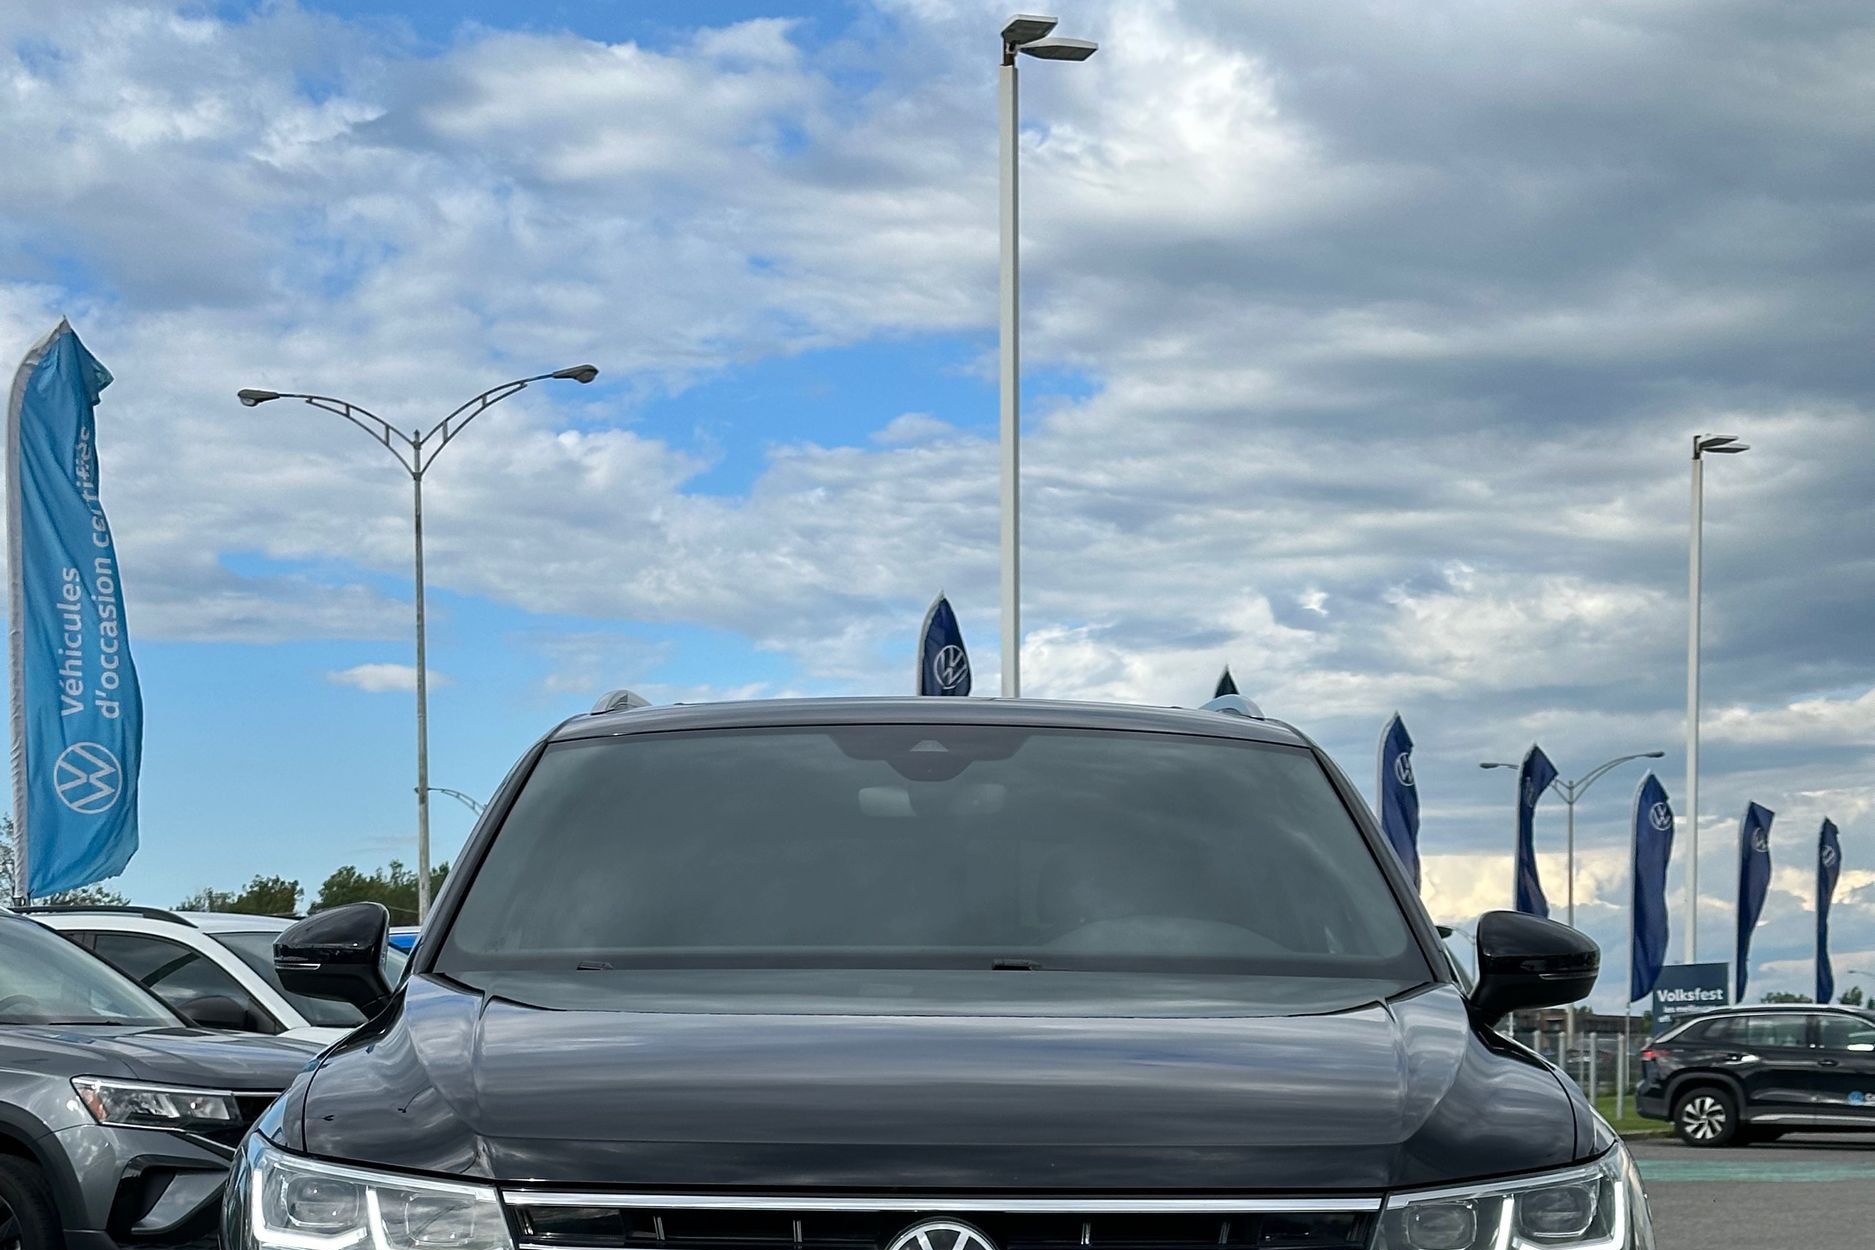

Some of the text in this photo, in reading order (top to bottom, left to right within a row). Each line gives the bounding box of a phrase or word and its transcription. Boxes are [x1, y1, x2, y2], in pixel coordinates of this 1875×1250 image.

[57, 567, 84, 716] Véhicules
[91, 557, 119, 719] d'occasion
[934, 644, 969, 689] VW
[55, 743, 122, 814] VW
[1657, 987, 1724, 1002] Volksfest
